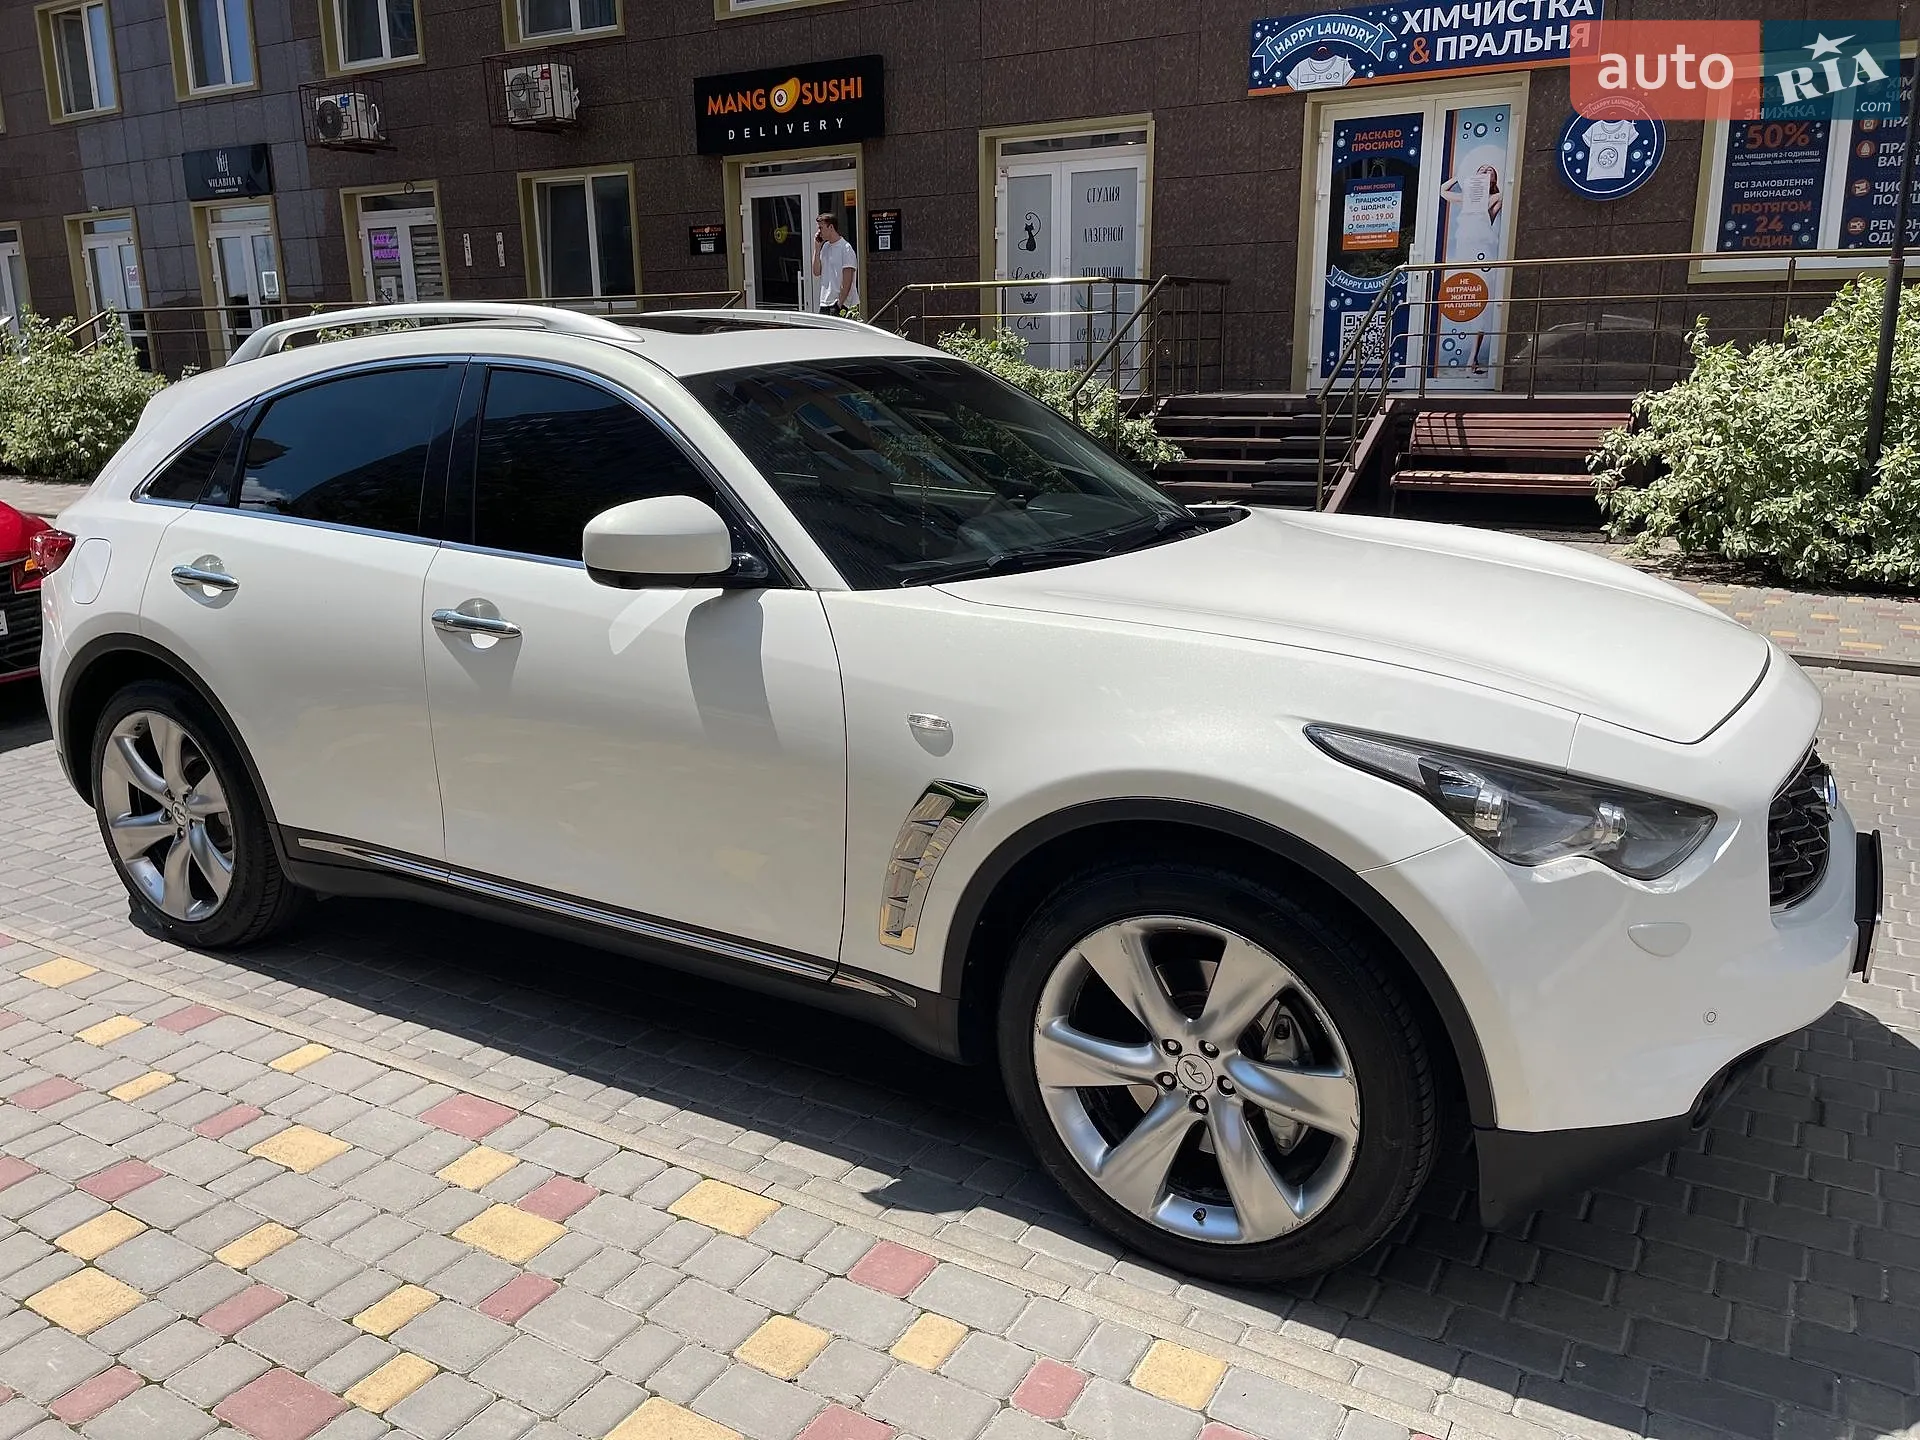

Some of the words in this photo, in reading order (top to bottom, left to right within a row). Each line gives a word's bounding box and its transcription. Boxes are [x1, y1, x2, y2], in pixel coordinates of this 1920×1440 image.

[1400, 0, 1594, 35] ХІМЧИСТКА
[1273, 25, 1314, 55] HAPPY
[1318, 22, 1374, 44] LAUNDRY
[1409, 37, 1429, 64] &
[1436, 23, 1590, 62] ПРАЛЬНЯ
[802, 77, 862, 105] SUSHI
[1744, 104, 1816, 120] ЗНИЖКА
[728, 118, 843, 140] DELIVERY
[1355, 129, 1401, 141] ЛАСКАВО
[1746, 122, 1811, 149] 50%
[1352, 139, 1404, 152] ПРОСИМО!
[1750, 178, 1814, 188] ЗАМОВЛЕННЯ
[1087, 186, 1120, 203] СТУДИЯ
[1743, 189, 1802, 198] ВИКОНАЄМО
[1731, 201, 1812, 214] ПРОТЯГОМ
[1755, 215, 1784, 233] 24
[1084, 224, 1124, 242] ЛАЗЕРНОЙ
[1742, 235, 1793, 247] ГОДИН
[1337, 276, 1362, 289] HAPPY
[1446, 285, 1482, 293] ВИТРАЧАЙ
